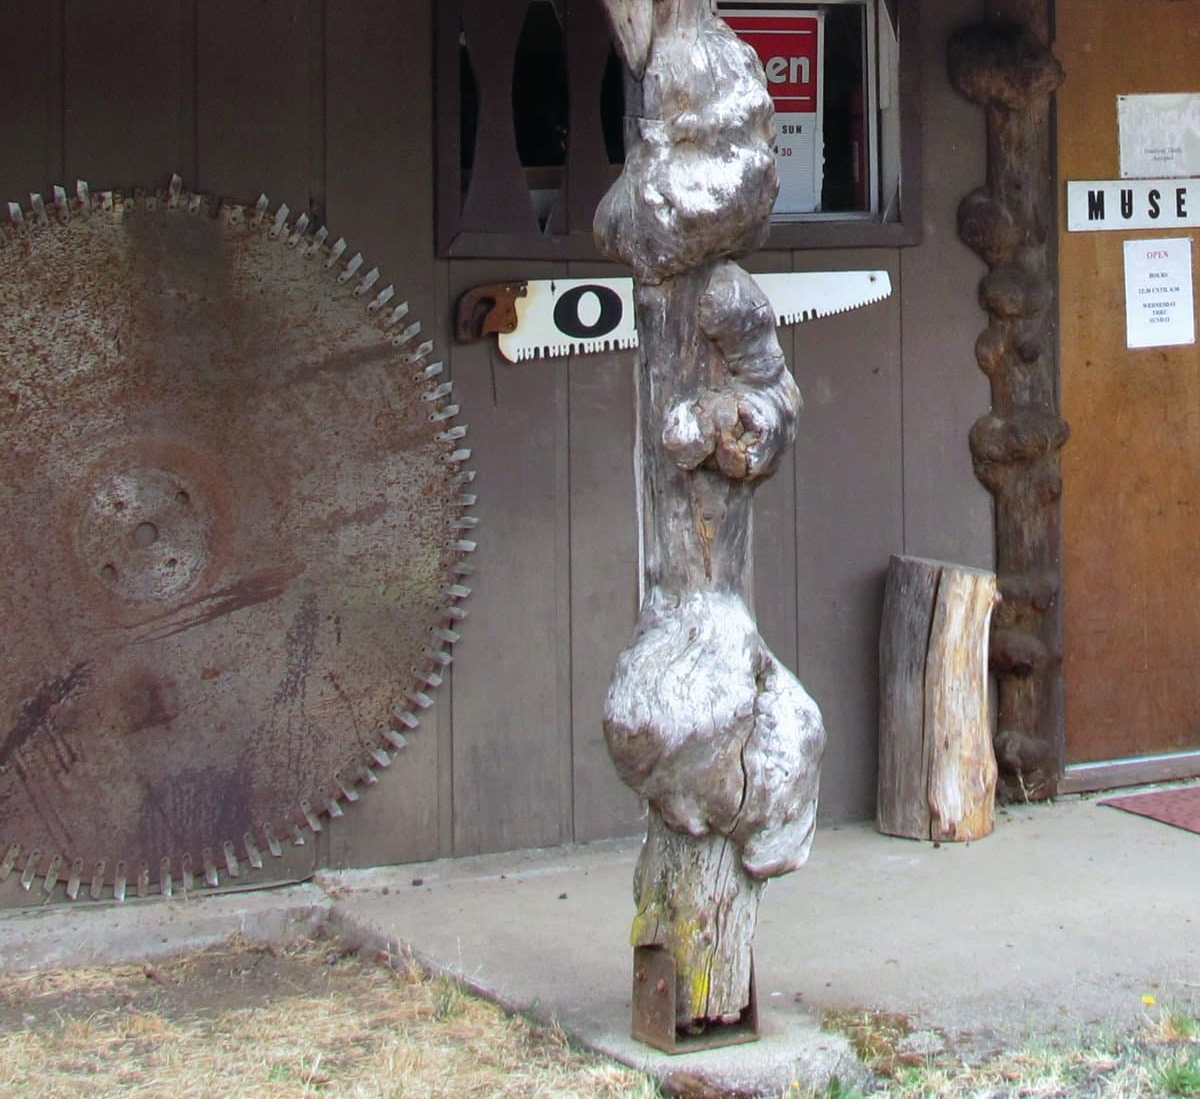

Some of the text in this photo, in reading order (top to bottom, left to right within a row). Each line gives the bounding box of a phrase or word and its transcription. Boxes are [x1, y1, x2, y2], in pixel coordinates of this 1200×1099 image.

[765, 56, 810, 84] en
[782, 125, 802, 134] SUN
[1146, 251, 1169, 260] OPEN
